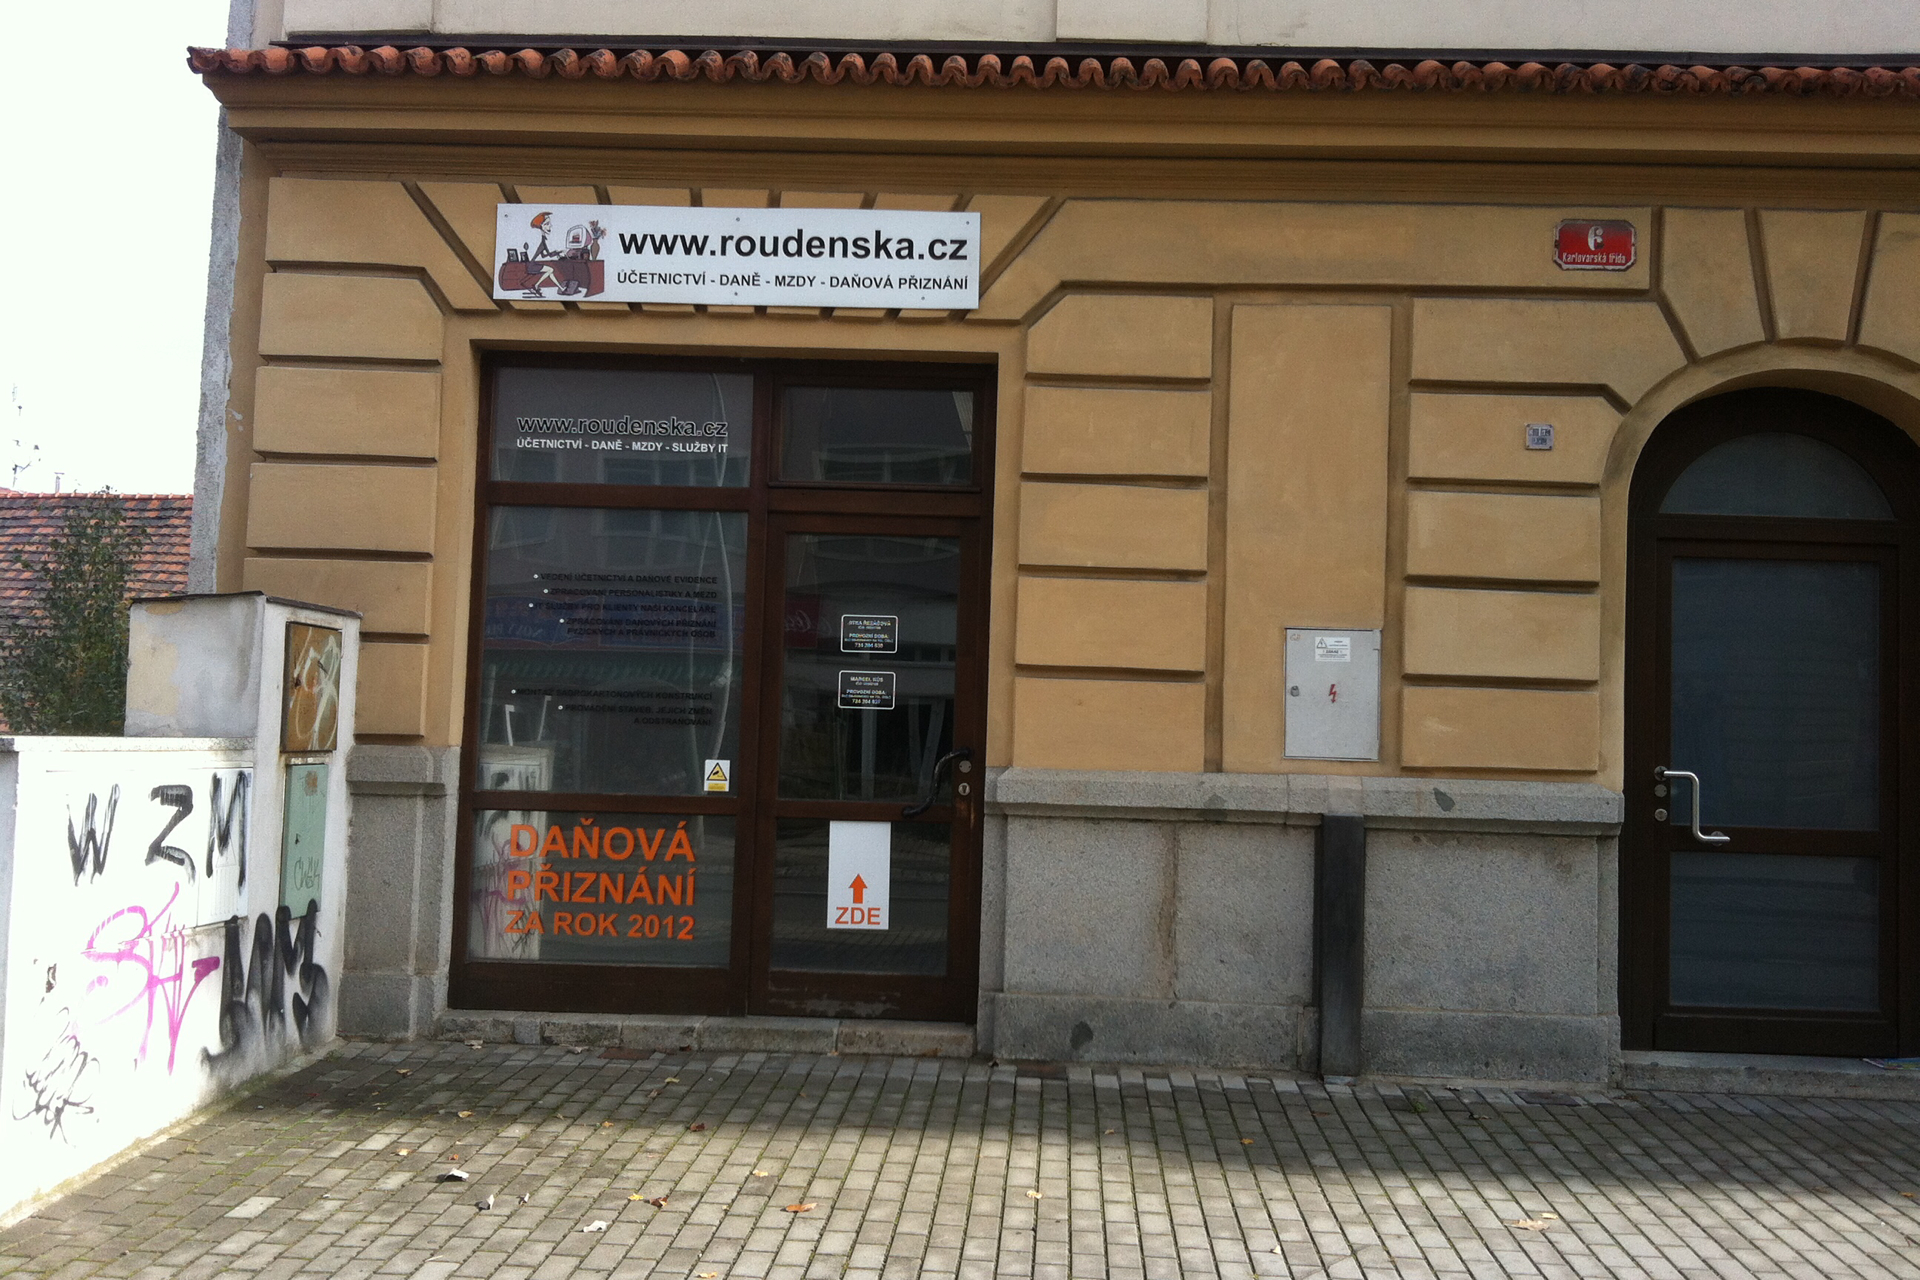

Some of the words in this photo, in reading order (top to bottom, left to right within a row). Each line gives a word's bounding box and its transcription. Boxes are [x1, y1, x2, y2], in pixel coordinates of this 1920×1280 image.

[618, 228, 968, 261] www.roudenska.cz
[1562, 252, 1607, 263] Karlovarská
[1608, 253, 1626, 264] třída
[617, 269, 706, 285] ÚČETNICTVÍ
[719, 271, 761, 286] DANĚ
[775, 275, 816, 287] MZDY
[830, 273, 894, 289] DAŇOVÁ
[899, 274, 968, 290] PŘIZNÁNÍ
[516, 415, 728, 437] www.roudenska.cz
[516, 436, 582, 450] ÚČETNICTVÍ
[591, 438, 623, 451] DANĚ
[632, 441, 663, 452] MZDY
[672, 441, 716, 453] SLUŽBY
[718, 443, 729, 453] IT
[674, 576, 718, 584] EVIDENCE
[603, 603, 638, 611] KLIENTY
[509, 817, 696, 862] DAŇOVÁ
[506, 863, 697, 906] PŘIZNÁNÍ
[504, 910, 545, 934] ZA
[553, 911, 619, 937] ROK
[627, 913, 695, 940] 2012
[834, 906, 881, 926] ZDE
